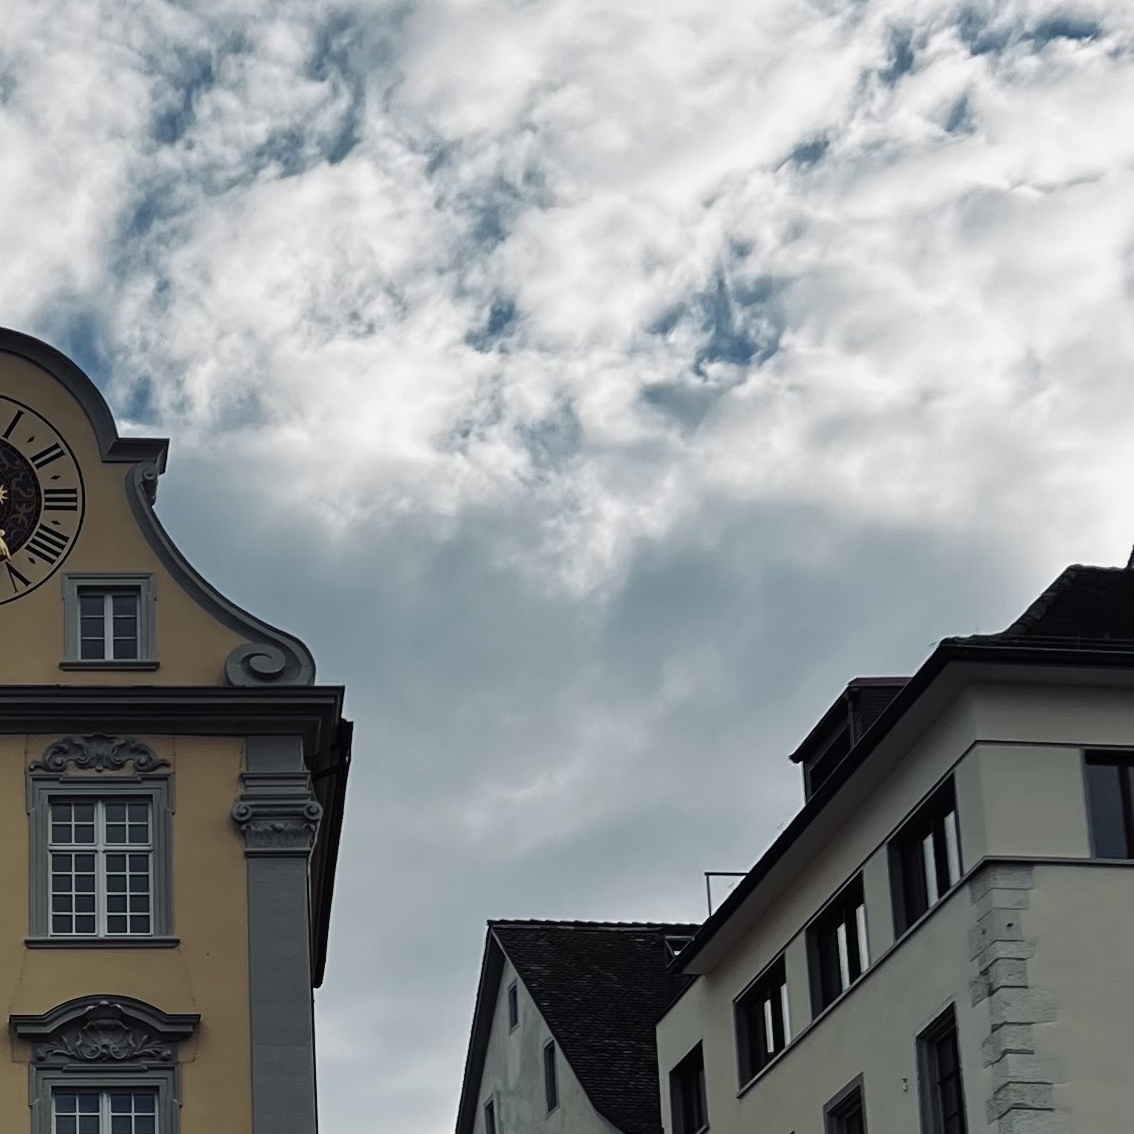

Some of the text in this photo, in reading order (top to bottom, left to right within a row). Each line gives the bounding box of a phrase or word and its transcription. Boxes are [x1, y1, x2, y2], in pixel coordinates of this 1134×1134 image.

[2, 410, 24, 439] I
[29, 442, 66, 470] II
[44, 488, 77, 511] III
[24, 523, 70, 565] IIII
[5, 561, 32, 593] V
